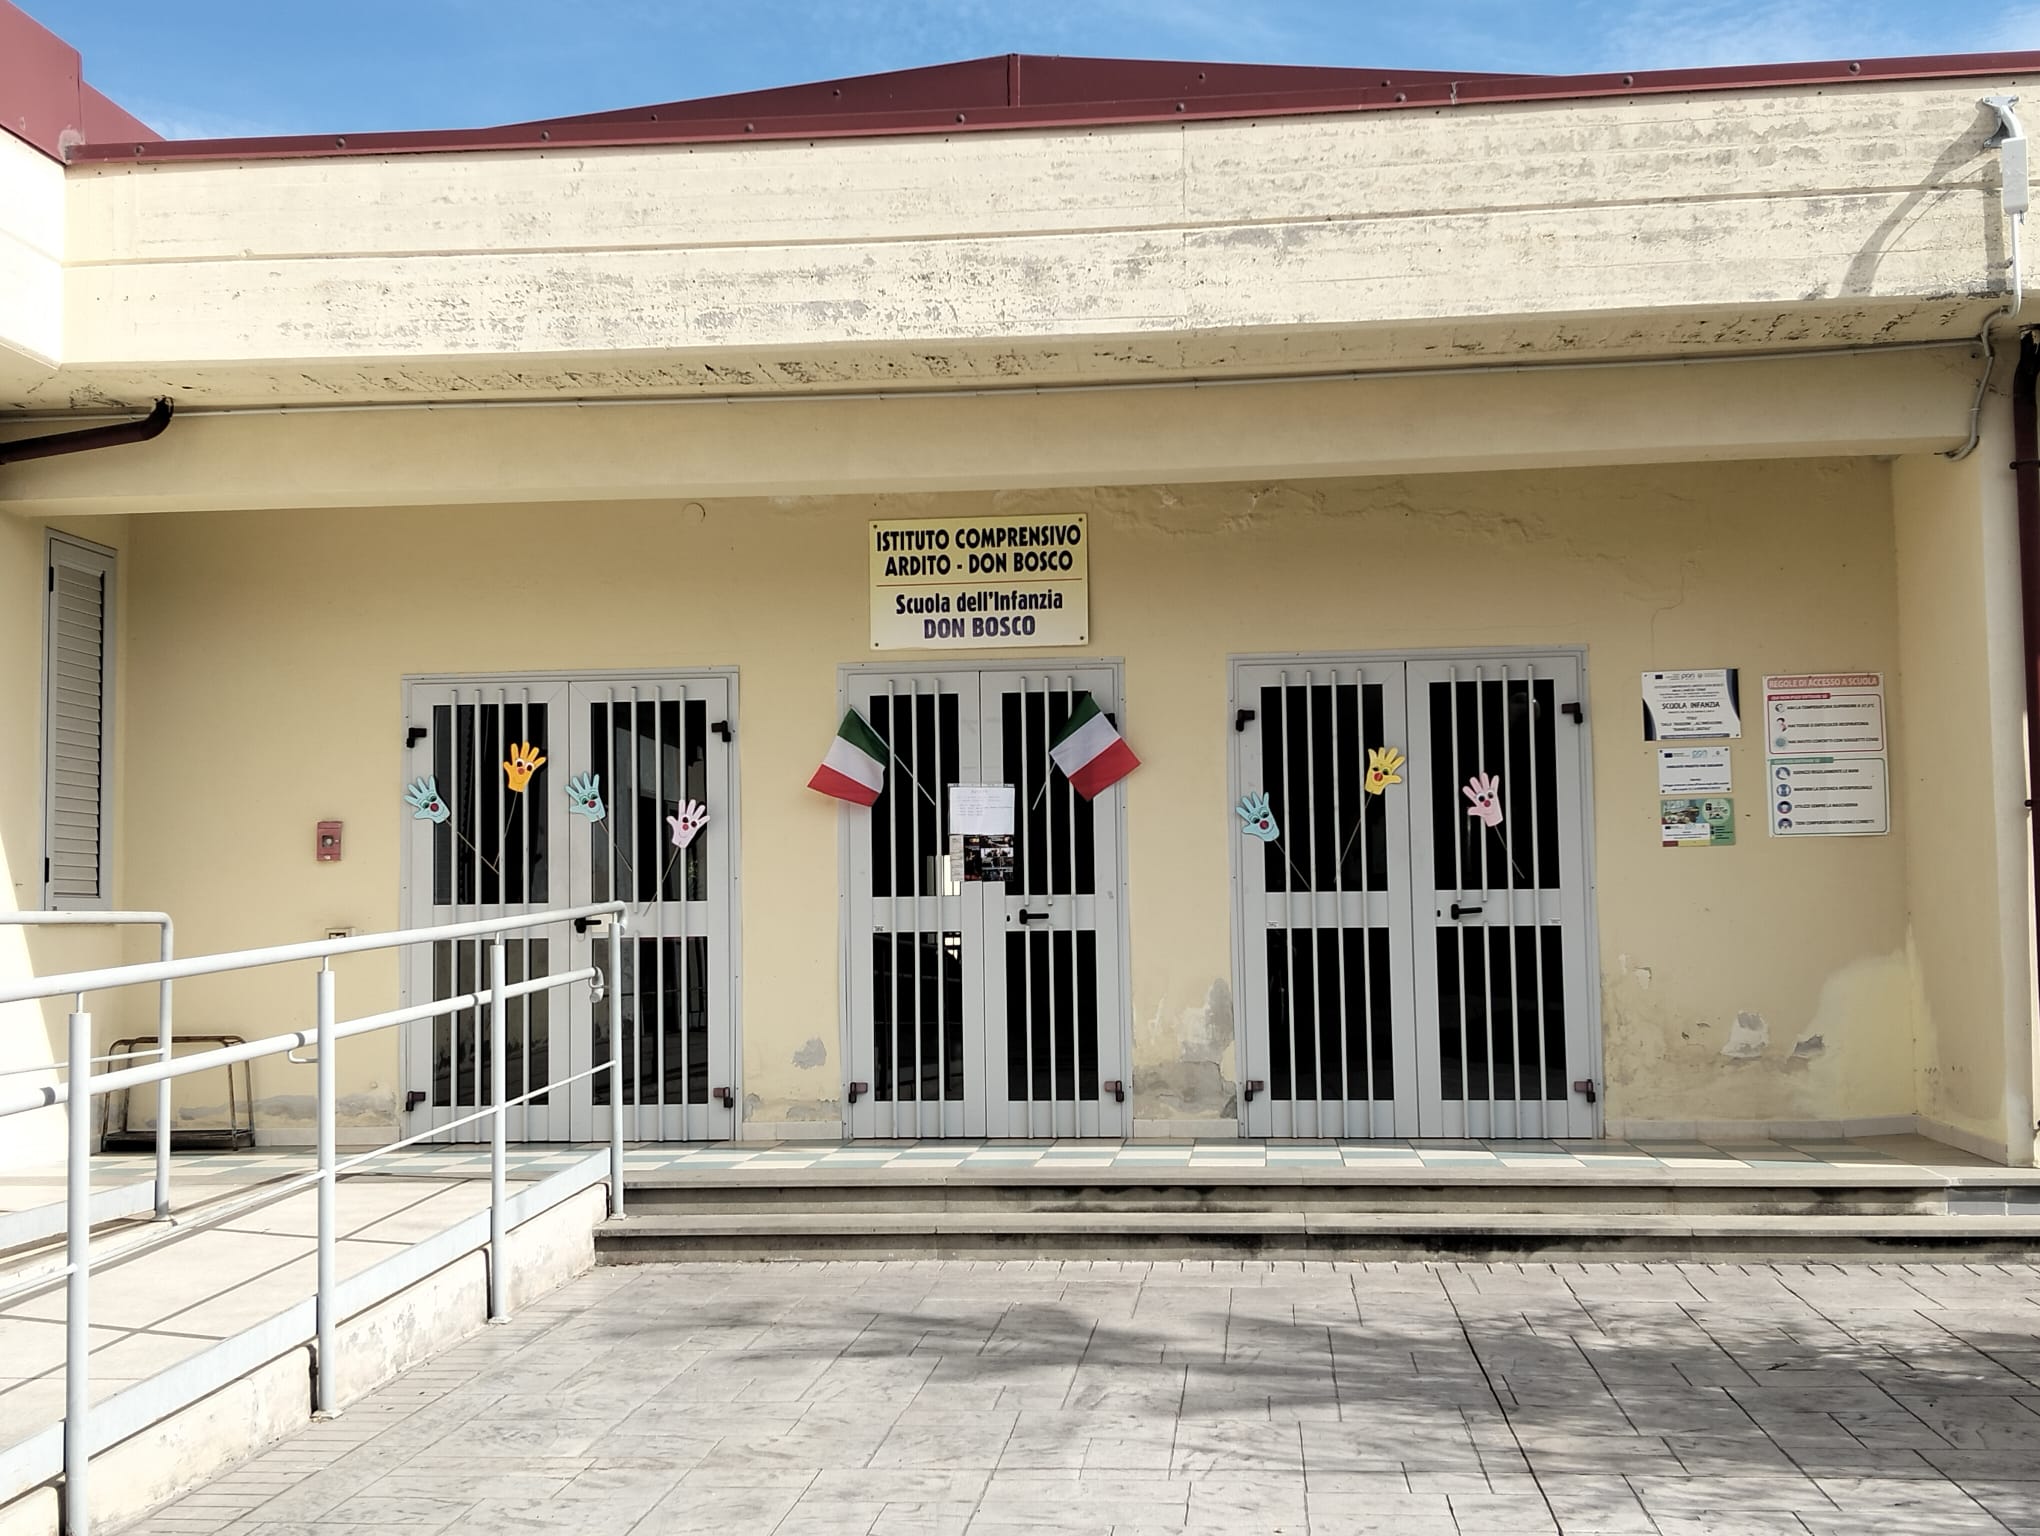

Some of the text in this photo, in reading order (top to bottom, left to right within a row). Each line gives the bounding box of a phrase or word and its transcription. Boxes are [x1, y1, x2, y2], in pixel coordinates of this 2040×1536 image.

[877, 524, 1081, 551] ISTITUTO COMPRENSIVO
[885, 554, 951, 576] ARDITO
[969, 553, 1007, 573] DON
[1013, 550, 1073, 572] BOSCO
[896, 589, 1063, 615] Scuola dell'Infanzia
[924, 615, 1036, 639] DON BOSCO
[1769, 680, 1797, 688] REGOLE
[1798, 679, 1807, 687] DI
[1808, 678, 1840, 687] ACCESSO
[1849, 677, 1877, 686] SCUOLA
[1661, 701, 1720, 710] SCUOLA INFANZIA
